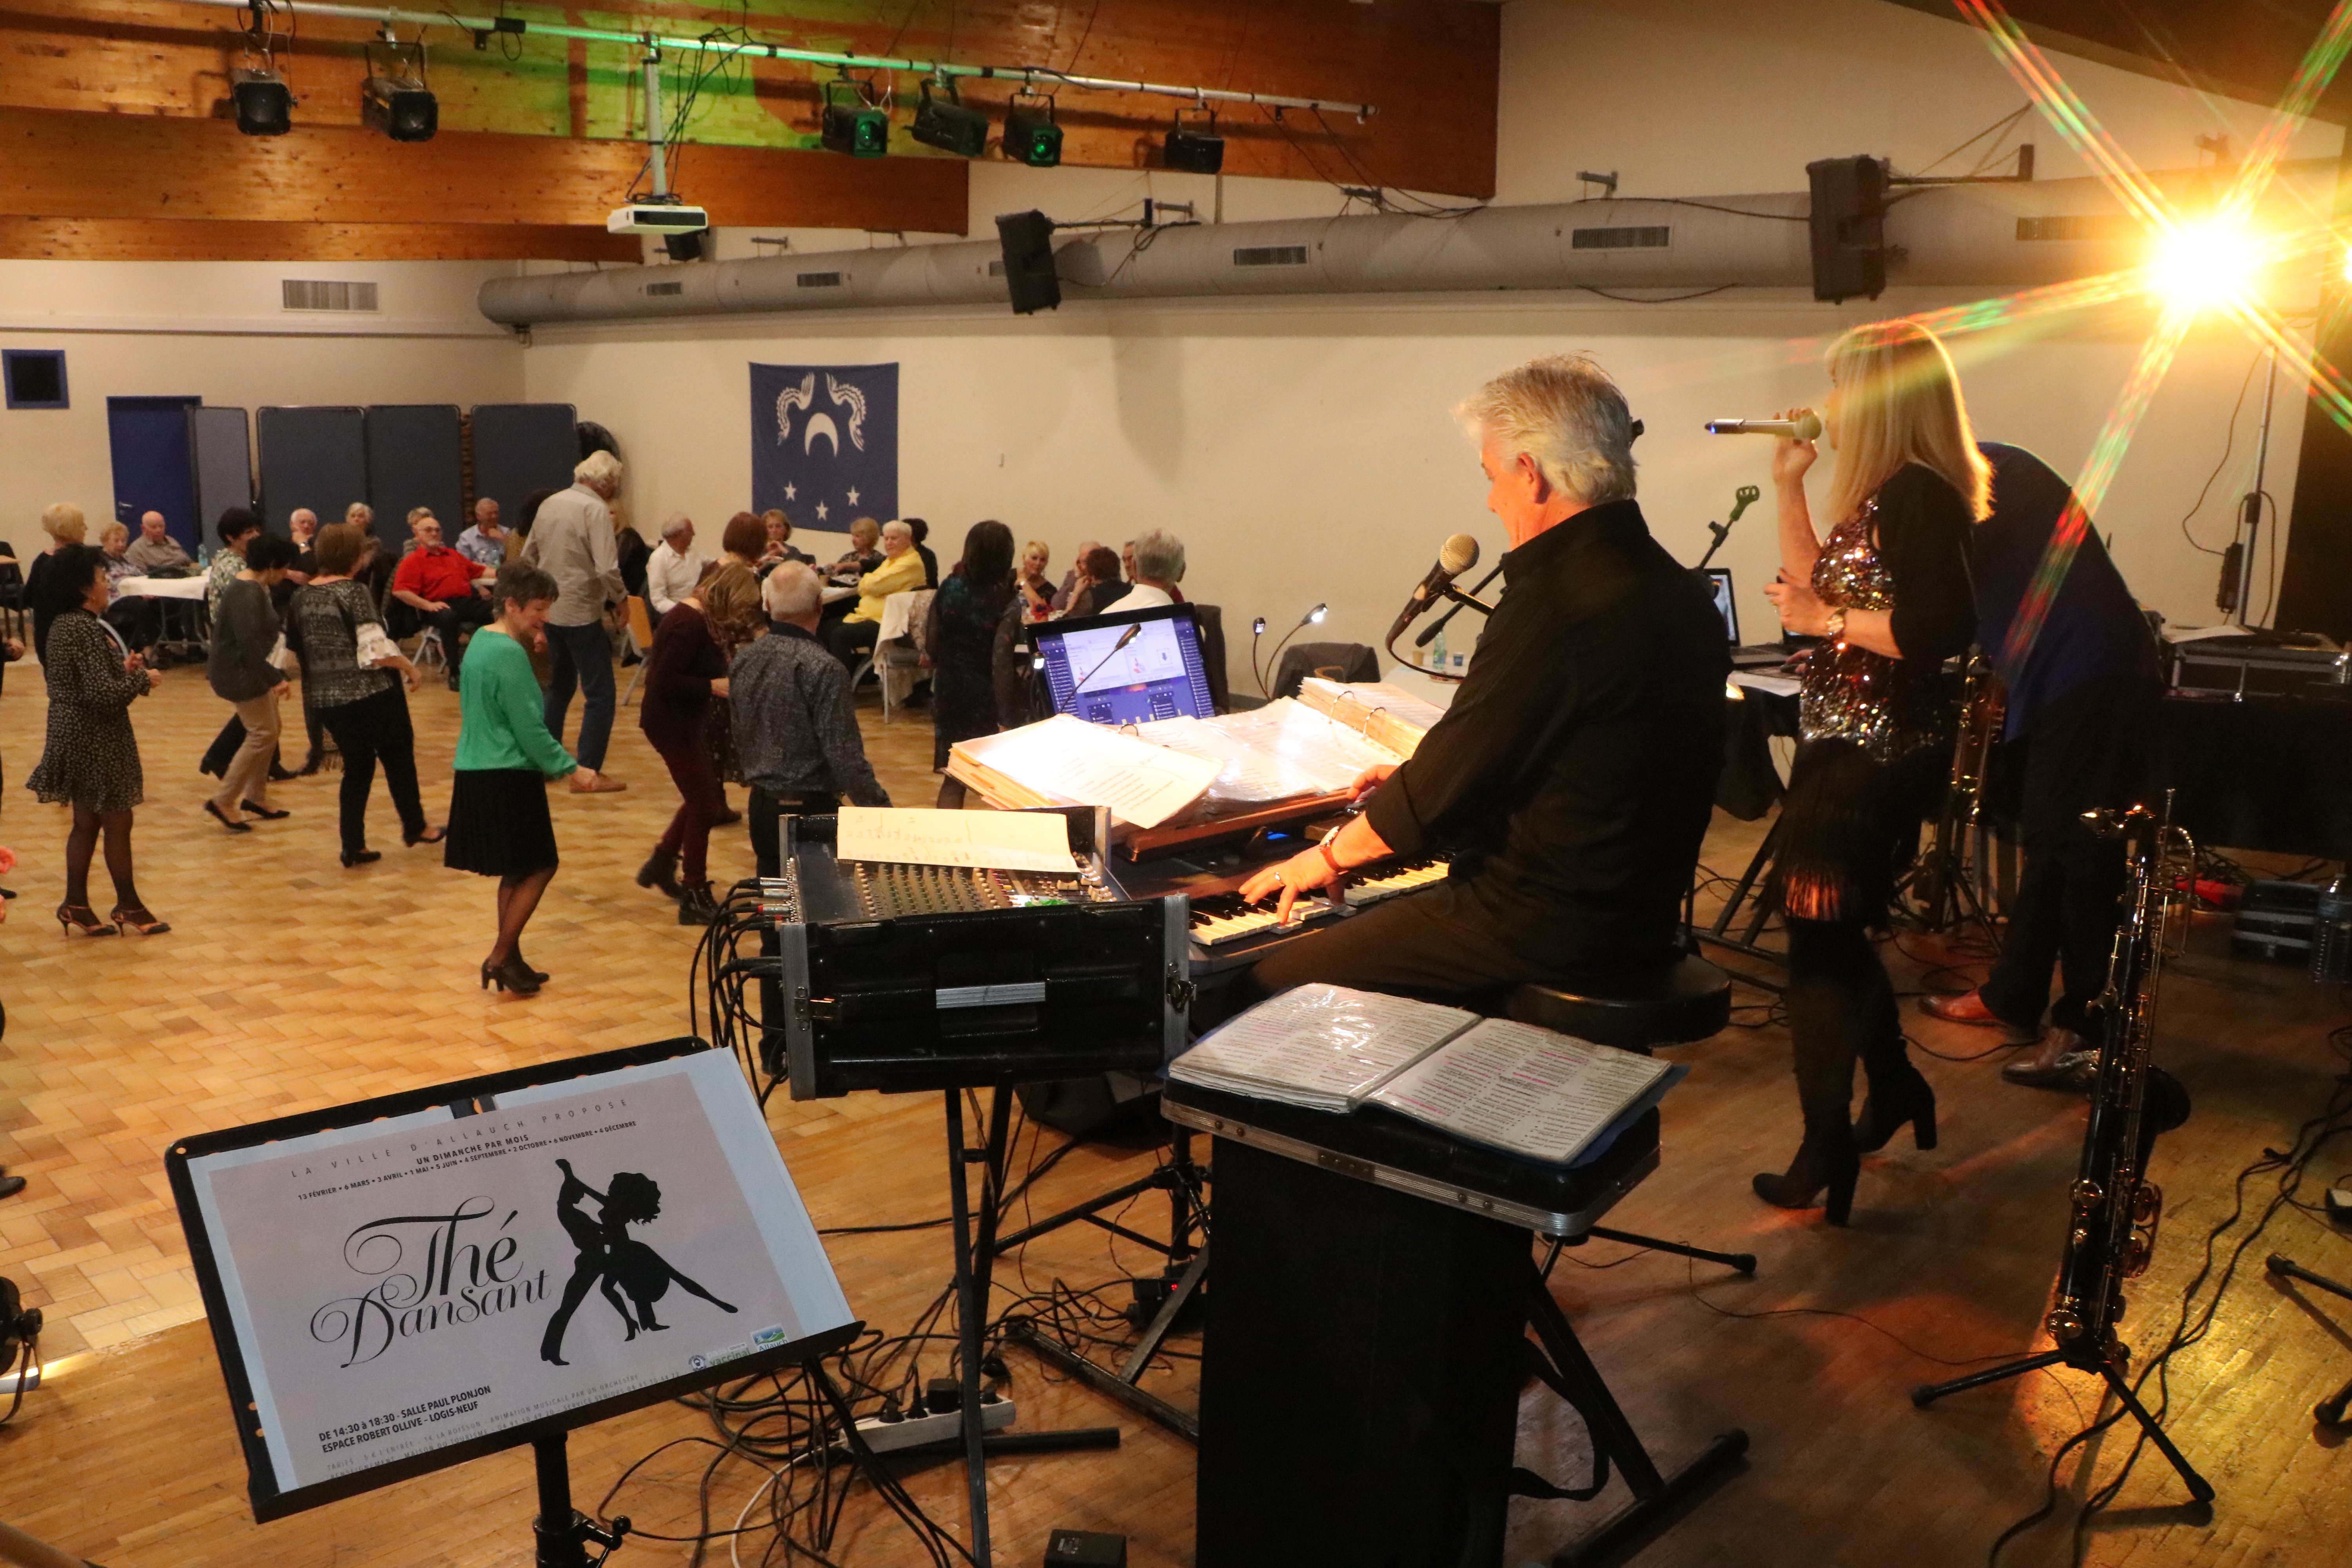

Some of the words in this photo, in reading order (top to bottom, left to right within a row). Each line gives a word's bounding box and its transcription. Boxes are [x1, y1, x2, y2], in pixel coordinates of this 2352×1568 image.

[292, 1167, 311, 1177] LA
[331, 1149, 391, 1168] VILLE
[410, 1121, 524, 1151] D'ALLAUCH
[541, 1099, 626, 1123] PROPOSE
[309, 1187, 337, 1198] FÉVRIER
[350, 1179, 370, 1189] MARS
[383, 1172, 403, 1181] AVRIL
[442, 1160, 457, 1169] JUIN
[470, 1149, 507, 1161] SEPTEMBRE
[519, 1140, 548, 1151] OCTOBRE
[559, 1130, 593, 1142] NOVEMBRE
[604, 1120, 637, 1132] DÉCEMBRE
[433, 1145, 482, 1161] DIMANCHE
[485, 1140, 503, 1149] PAR
[505, 1134, 529, 1145] MOIS
[344, 1196, 524, 1308] Thé
[310, 1269, 551, 1368] Dansant
[759, 1338, 788, 1352] Allauch
[710, 1347, 750, 1366] vaccinal
[319, 1431, 331, 1441] DE
[333, 1423, 360, 1437] 14:30
[361, 1421, 367, 1430] à
[369, 1413, 395, 1427] 18:30
[401, 1403, 427, 1418] SALLE
[428, 1397, 450, 1411] PAUL
[450, 1385, 491, 1403] PLONJON
[322, 1437, 356, 1453] ESPACE
[357, 1426, 391, 1444] ROBERT
[392, 1417, 423, 1433] OLLIVE
[429, 1401, 479, 1423] LOGIS-NEUF
[448, 1421, 481, 1435] BOISSON
[490, 1406, 531, 1423] ANIMATION
[534, 1395, 568, 1410] MUSICALE
[572, 1390, 585, 1399] PAR
[600, 1374, 639, 1390] ORCHESTRE
